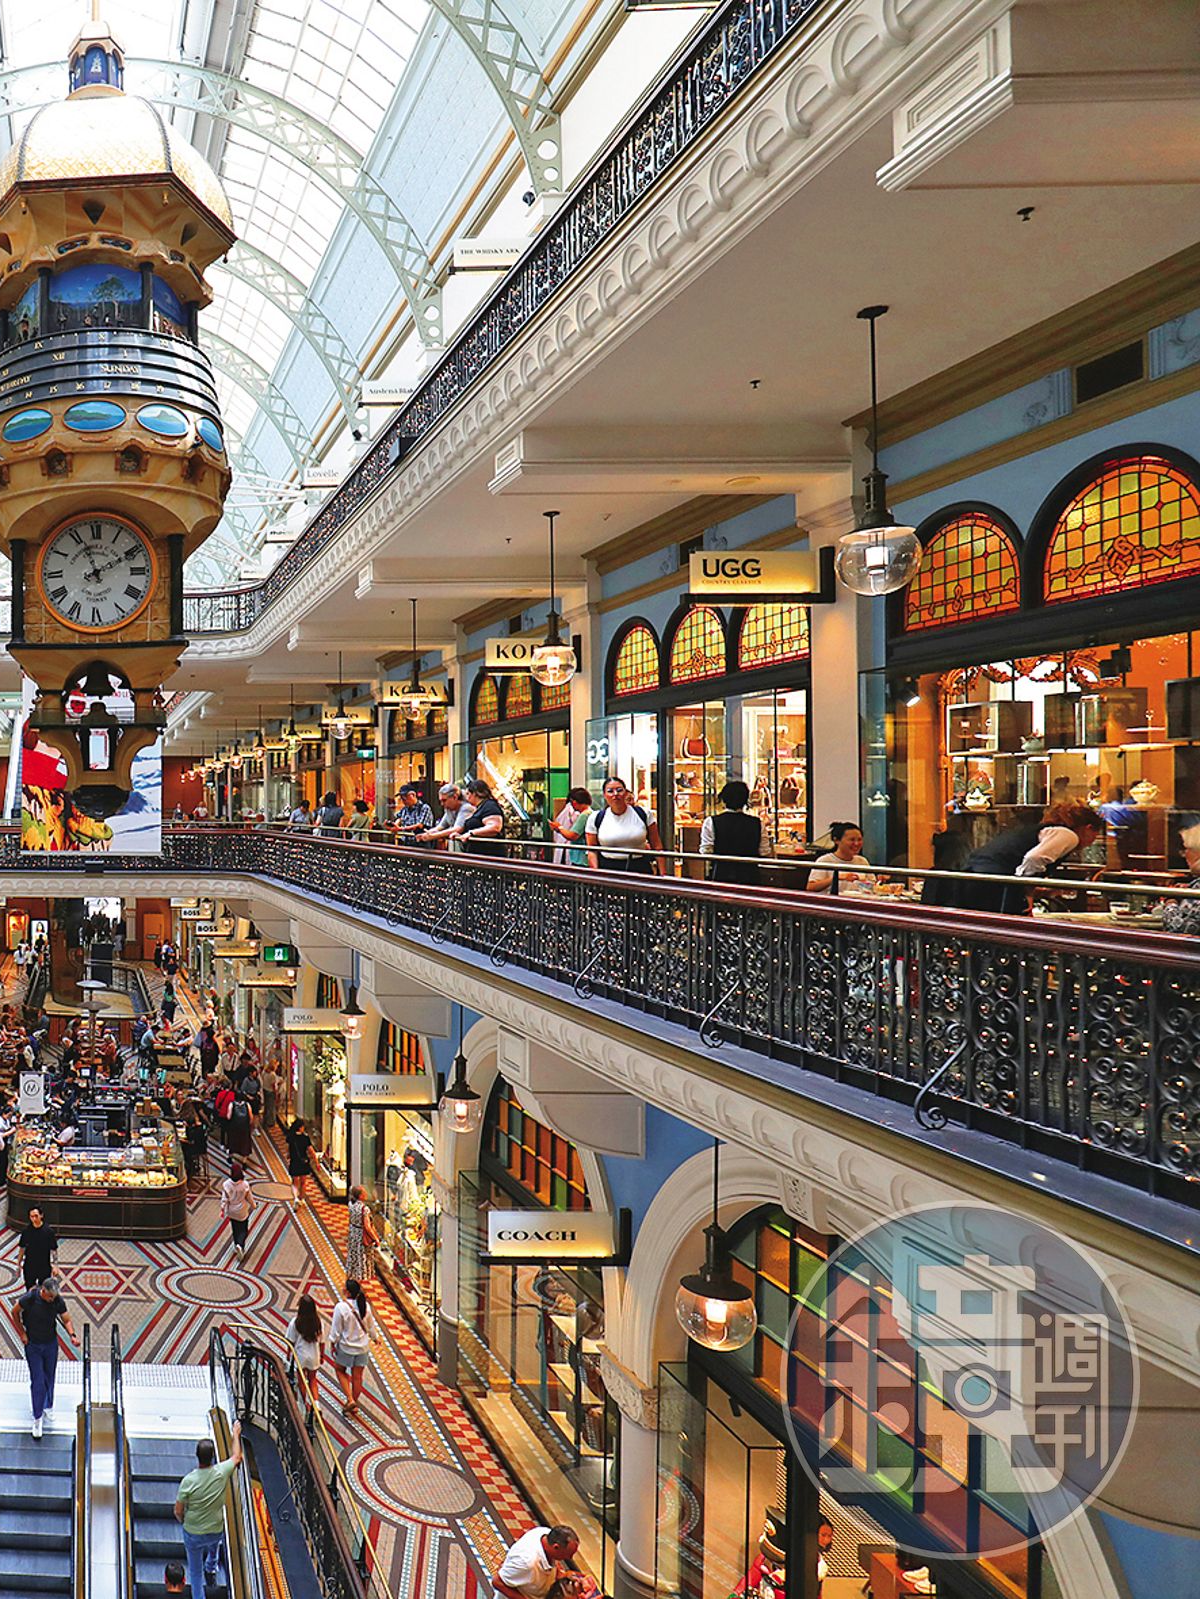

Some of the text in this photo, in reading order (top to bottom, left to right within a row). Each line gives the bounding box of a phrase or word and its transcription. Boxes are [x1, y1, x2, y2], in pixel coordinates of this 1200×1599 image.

[100, 363, 139, 374] SUNDAY
[702, 558, 762, 578] UGG
[362, 1083, 389, 1091] POLO
[497, 1230, 577, 1241] COACH
